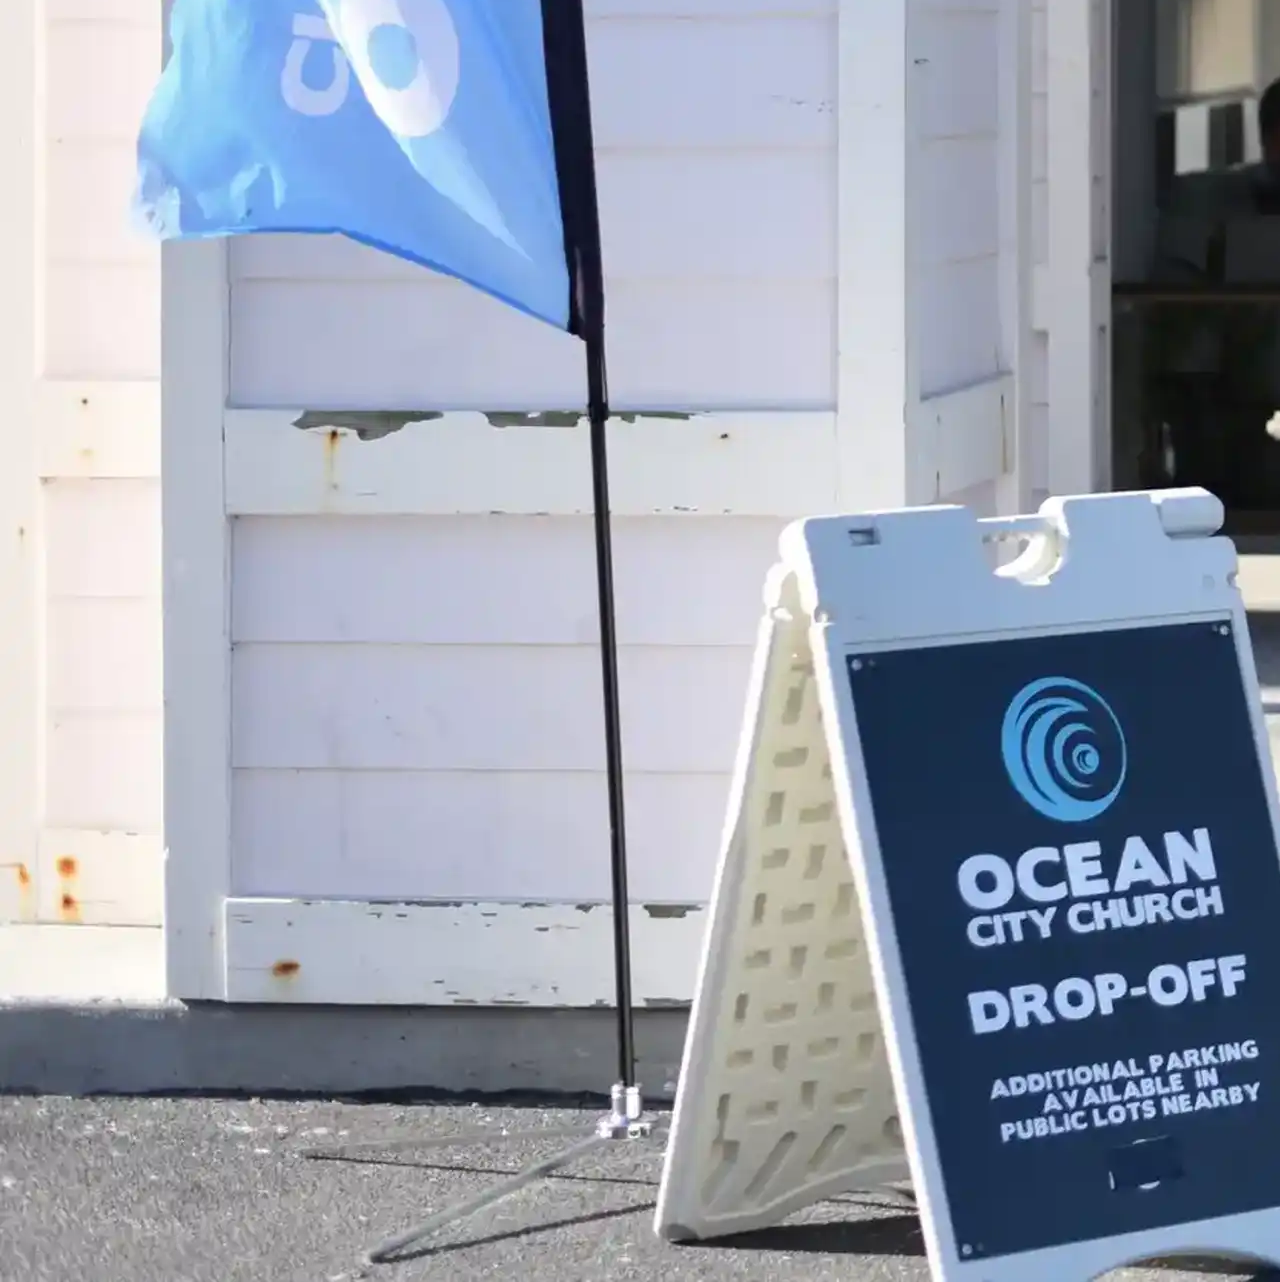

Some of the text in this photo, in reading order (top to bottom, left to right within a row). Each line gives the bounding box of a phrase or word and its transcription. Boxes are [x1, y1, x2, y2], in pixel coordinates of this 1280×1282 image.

[957, 827, 1217, 911] OCEAN
[966, 885, 1225, 947] CITY CHURCH
[967, 954, 1247, 1035] DROP-OFF
[990, 1040, 1260, 1100] ADDITIONAL PARKING
[1043, 1068, 1219, 1113] AVAILABLE IN
[1000, 1082, 1261, 1143] PUBLIC LOTS NEARBY
